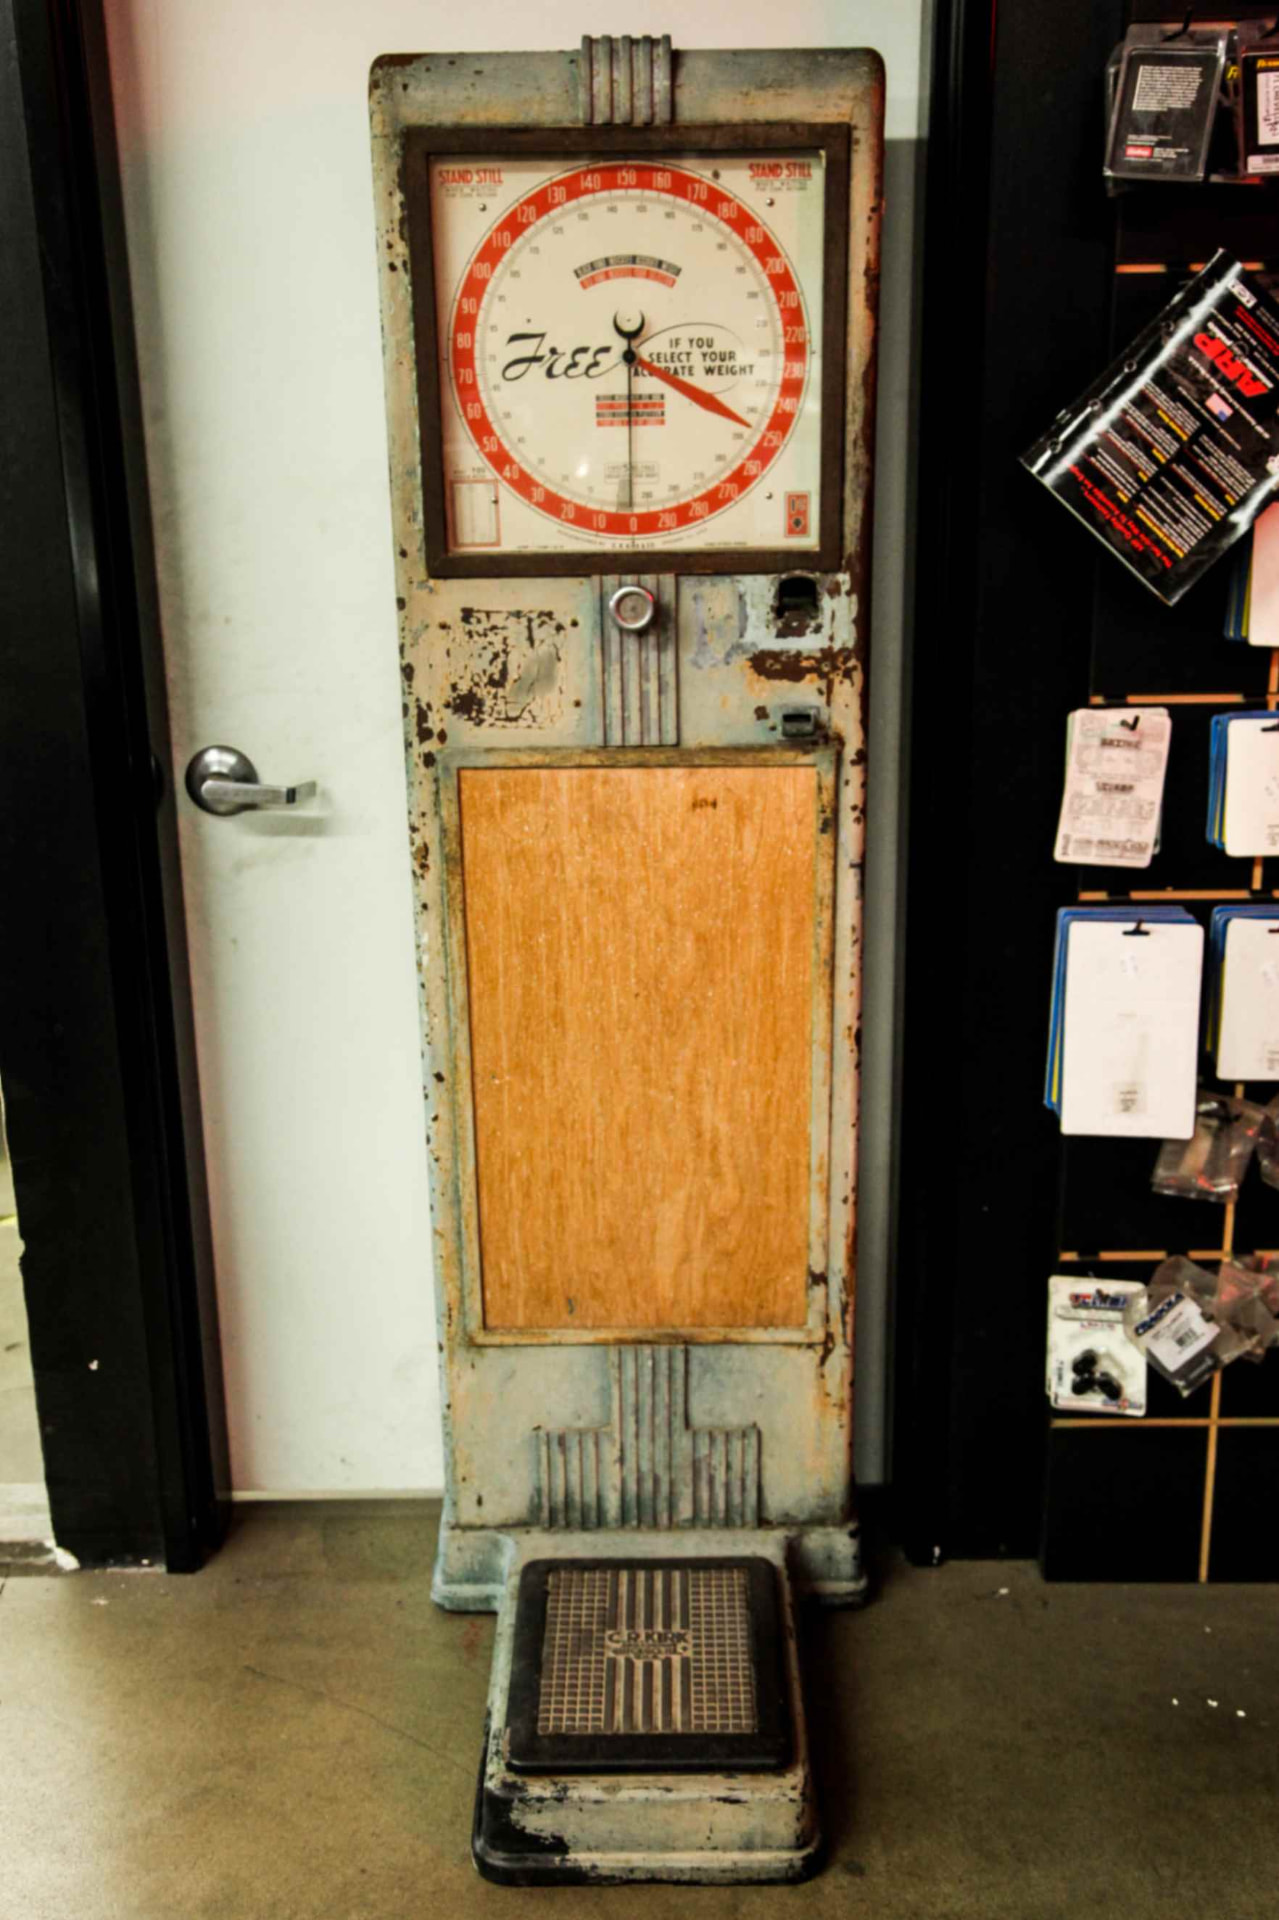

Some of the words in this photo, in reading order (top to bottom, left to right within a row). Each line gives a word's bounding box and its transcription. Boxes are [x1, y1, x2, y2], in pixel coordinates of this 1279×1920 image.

[439, 168, 472, 185] STAND
[476, 168, 503, 185] STILL
[617, 168, 636, 185] 150
[749, 162, 782, 179] STAND
[785, 162, 812, 179] STILL
[580, 174, 601, 190] 140
[652, 172, 671, 188] 160
[548, 187, 567, 203] 130
[687, 184, 708, 200] 170
[517, 206, 536, 222] 120
[718, 202, 738, 218] 180
[492, 232, 511, 248] 110
[745, 228, 764, 244] 190
[472, 263, 491, 278] 100
[765, 258, 785, 274] 200
[461, 298, 476, 314] 90
[779, 291, 798, 308] 210
[457, 333, 472, 349] 80
[669, 338, 681, 349] IF
[688, 337, 714, 349] YOU
[786, 327, 805, 343] 220
[648, 352, 692, 363] SELECT
[701, 351, 736, 362] YOUR
[1194, 332, 1269, 397] ARP
[459, 368, 473, 384] 70
[704, 364, 754, 376] WEIGHT
[783, 362, 804, 379] 230
[467, 403, 481, 419] 60
[777, 398, 797, 413] 240
[483, 436, 498, 452] 50
[763, 431, 783, 447] 250
[503, 465, 520, 480] 40
[743, 460, 761, 476] 260
[531, 487, 545, 502] 30
[718, 483, 739, 499] 270
[561, 504, 575, 519] 20
[689, 501, 709, 517] 280
[592, 514, 606, 528] 10
[630, 517, 638, 532] 0
[658, 513, 677, 528] 290
